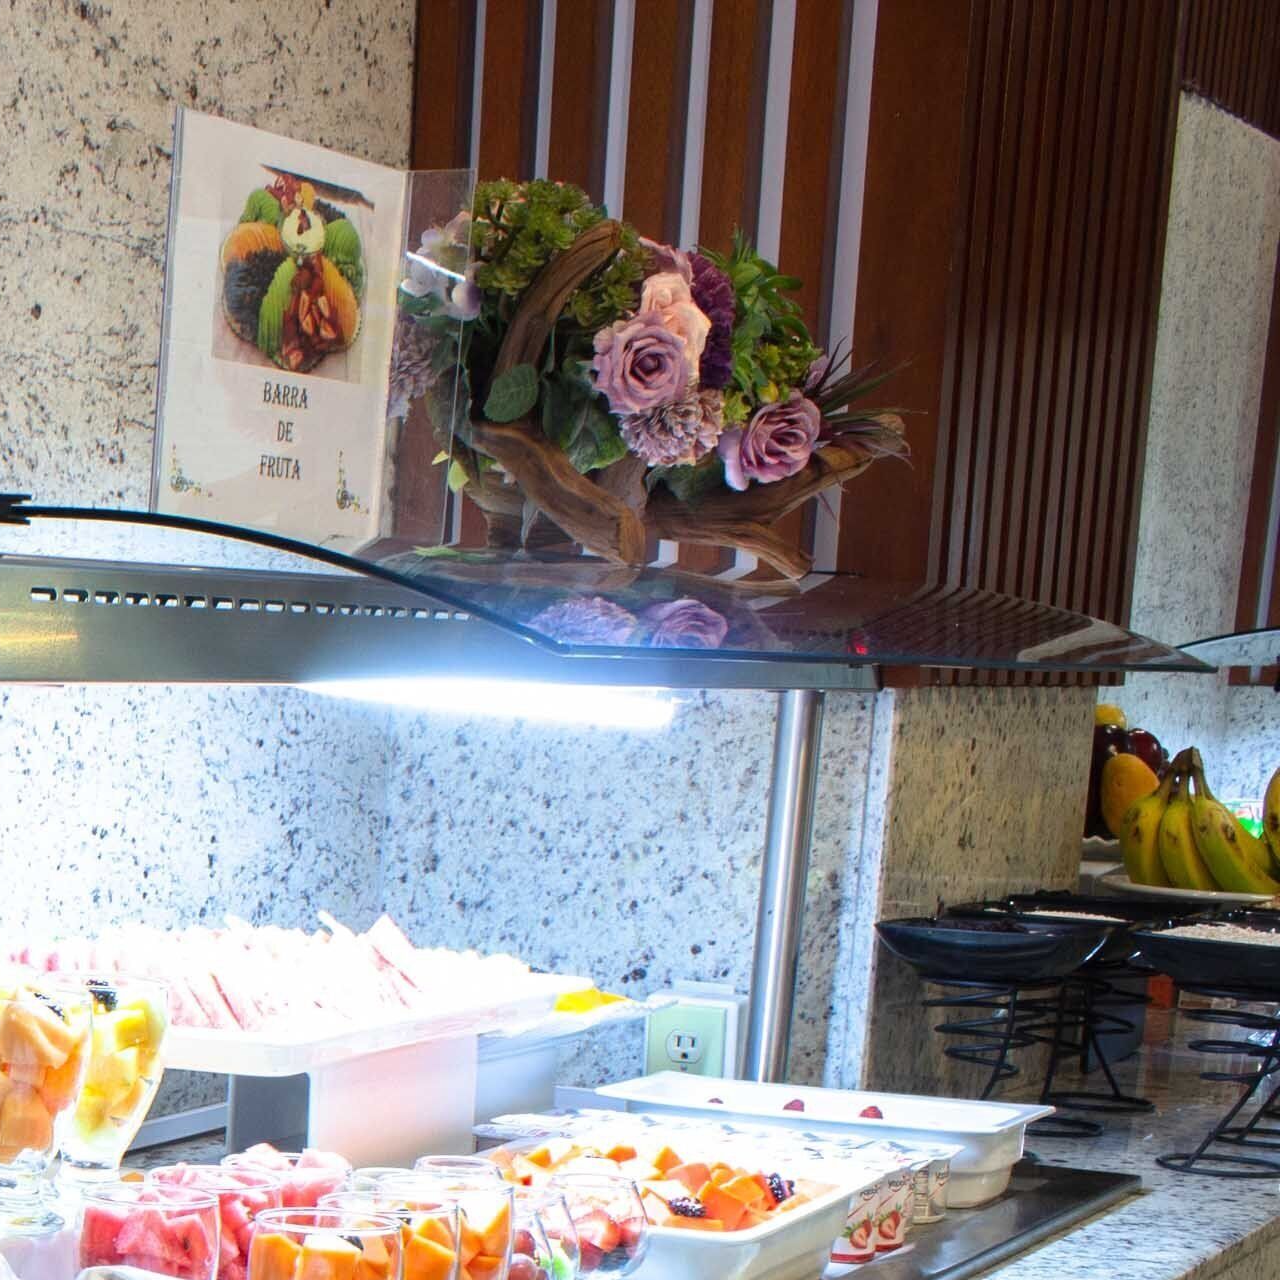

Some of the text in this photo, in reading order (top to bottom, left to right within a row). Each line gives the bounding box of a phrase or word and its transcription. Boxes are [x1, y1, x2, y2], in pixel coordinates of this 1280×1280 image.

[263, 381, 308, 409] BARRA
[277, 420, 294, 443] DE
[259, 454, 301, 480] FRUTA
